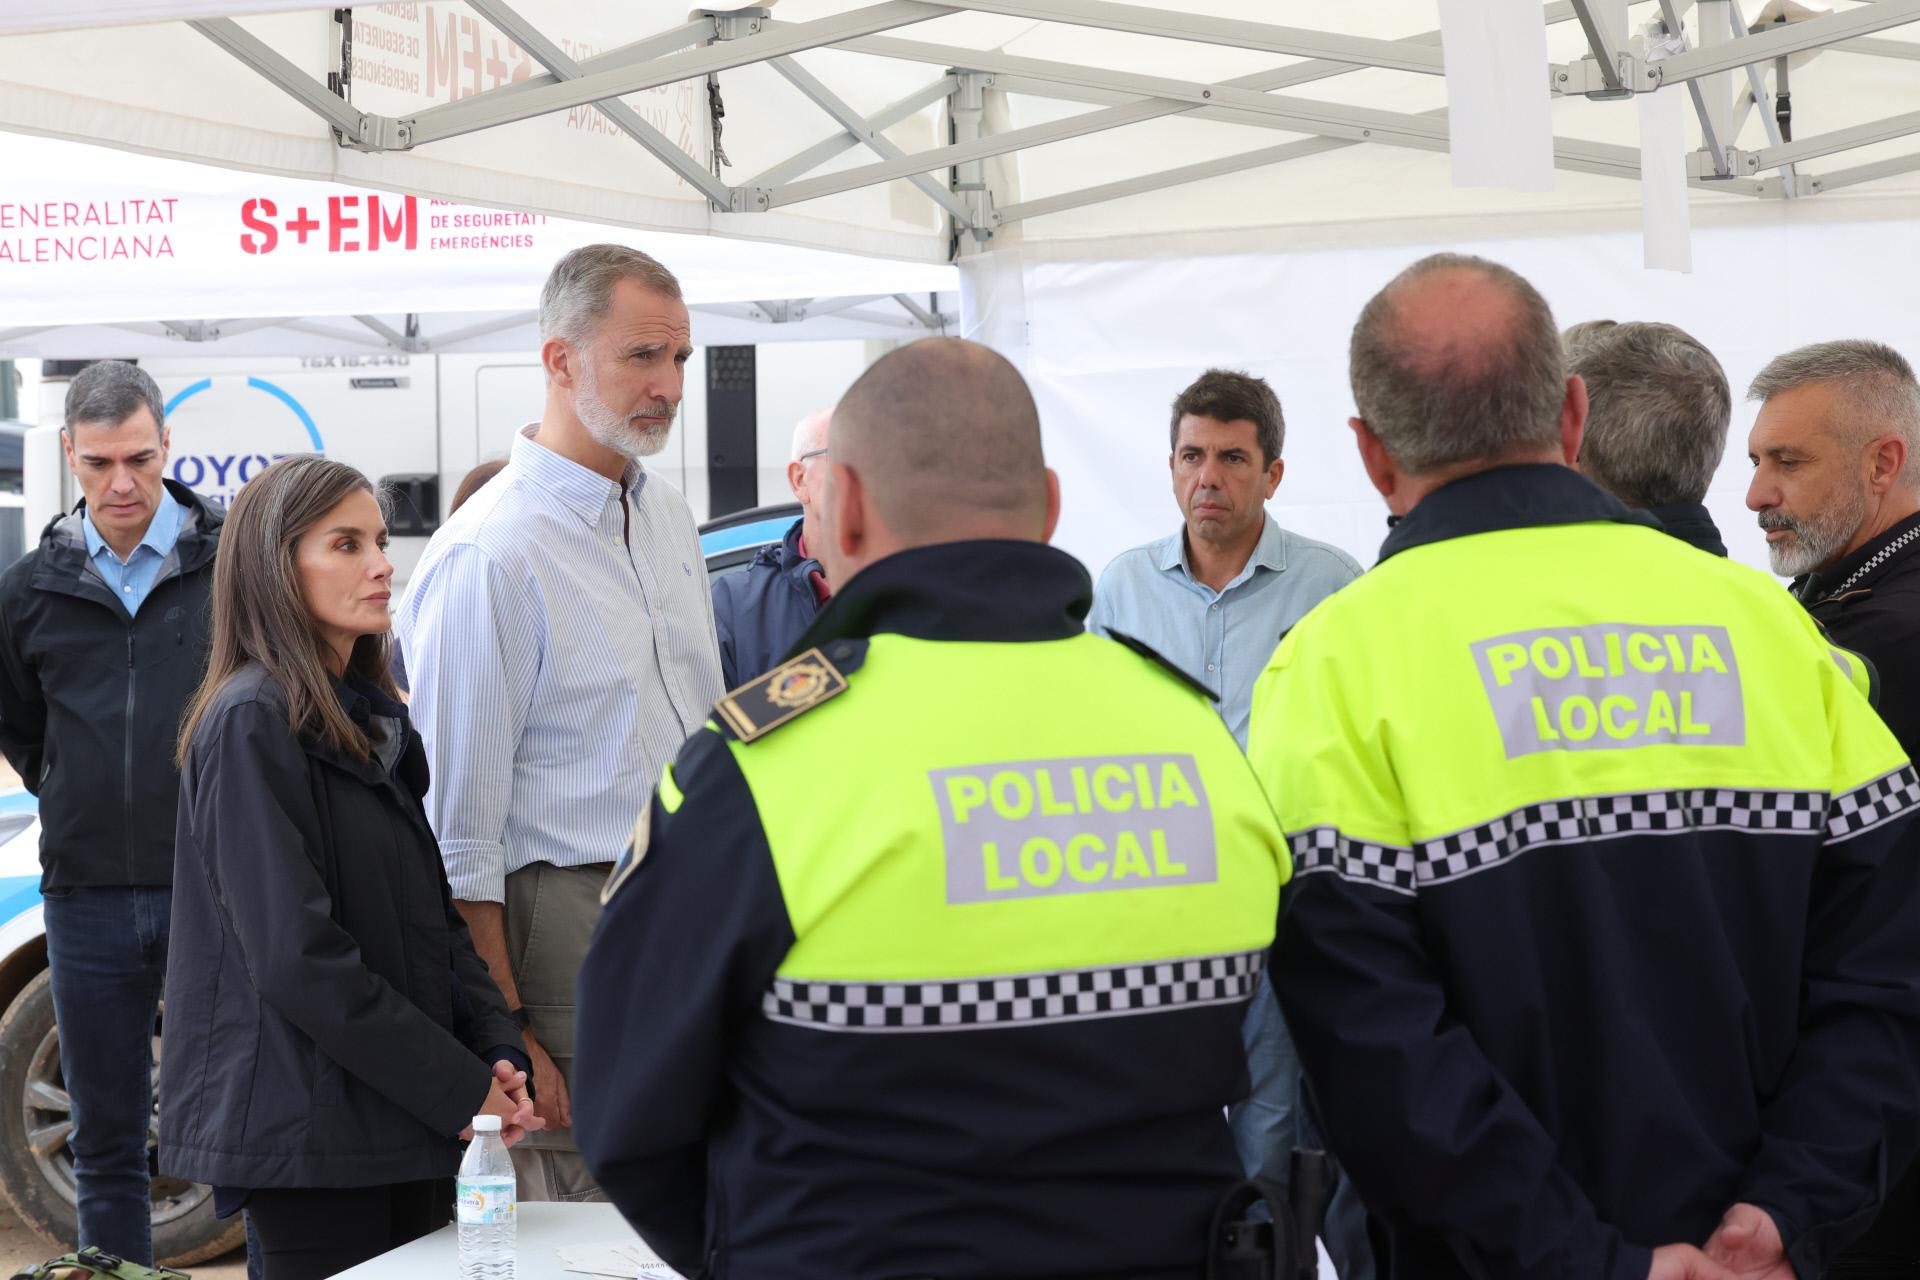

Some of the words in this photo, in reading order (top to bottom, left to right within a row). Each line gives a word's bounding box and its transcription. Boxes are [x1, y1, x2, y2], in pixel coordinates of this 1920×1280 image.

[240, 195, 418, 255] S+EM
[430, 215, 449, 229] DE
[430, 232, 533, 250] EMERGÈNCIES
[1485, 631, 1729, 687] POLICIA
[1530, 689, 1712, 741] LOCAL
[944, 761, 1200, 824] POLICIA
[981, 828, 1188, 892] LOCAL
